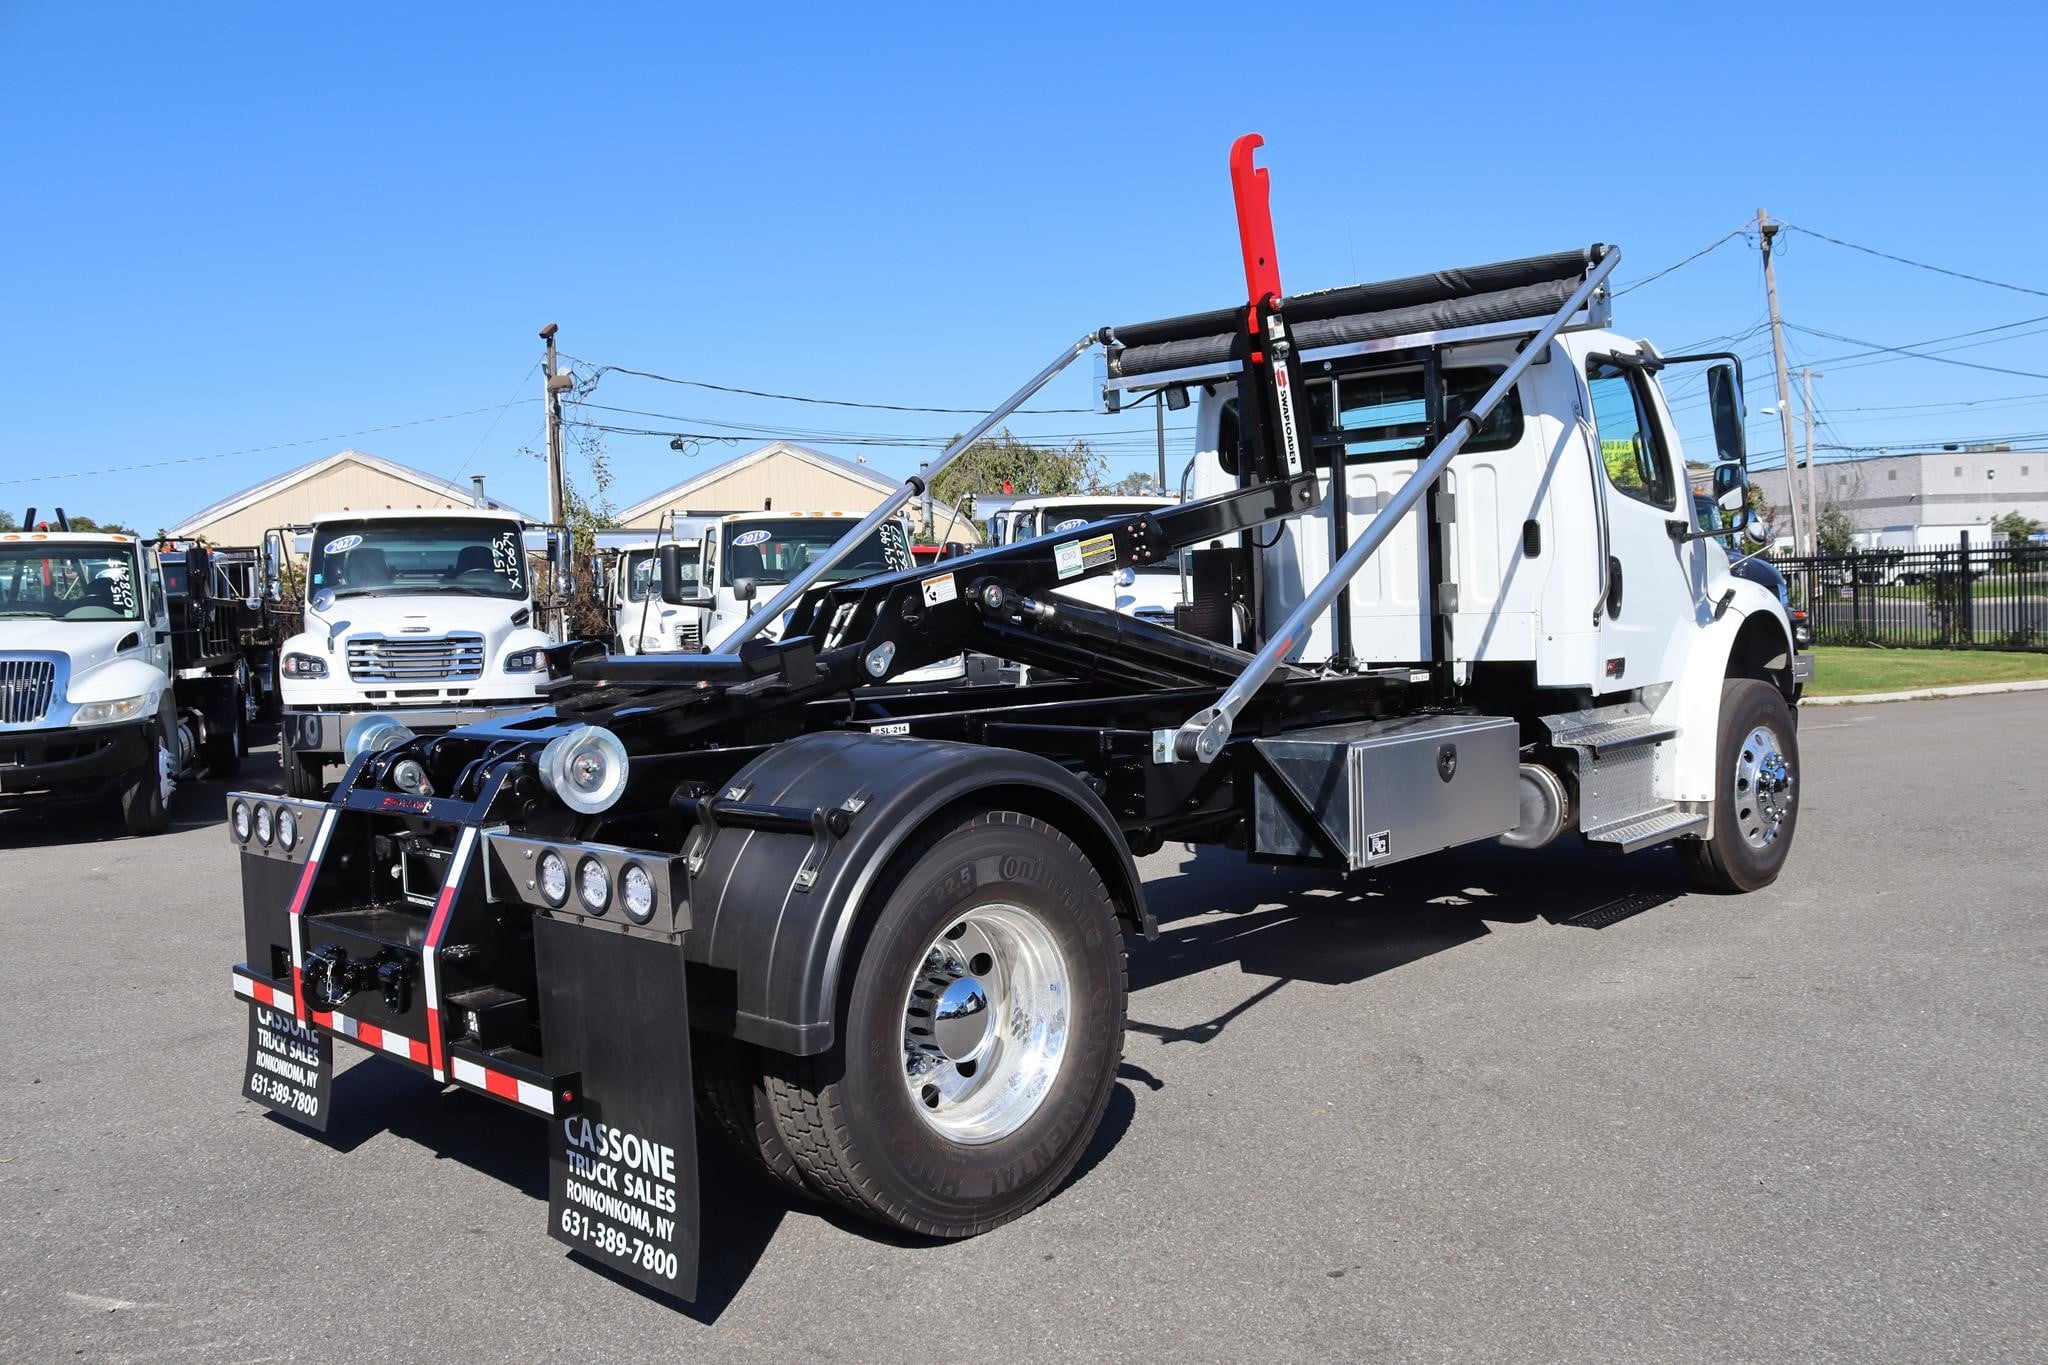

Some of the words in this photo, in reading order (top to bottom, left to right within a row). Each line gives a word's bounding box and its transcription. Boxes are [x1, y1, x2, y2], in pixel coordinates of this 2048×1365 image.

[1280, 390, 1297, 465] SWAPLOADER
[1616, 440, 1629, 450] AVE
[331, 536, 356, 552] 2027
[492, 537, 505, 572] 1575
[741, 532, 765, 545] 2019
[503, 532, 522, 589] XJ0674
[880, 725, 907, 735] SL-214
[257, 1027, 287, 1055] TRUCK
[289, 1040, 319, 1067] SALES
[256, 1050, 306, 1087] RONKONKOMA,
[307, 1069, 318, 1089] NY
[251, 1072, 318, 1116] 631-389-7800
[564, 1115, 676, 1184] CASSONE
[566, 1149, 618, 1192] TRUCK
[623, 1172, 676, 1214] SALES
[566, 1178, 655, 1238] RONKONKOMA,
[656, 1215, 675, 1243] NY
[561, 1208, 678, 1280] 631-389-7800
